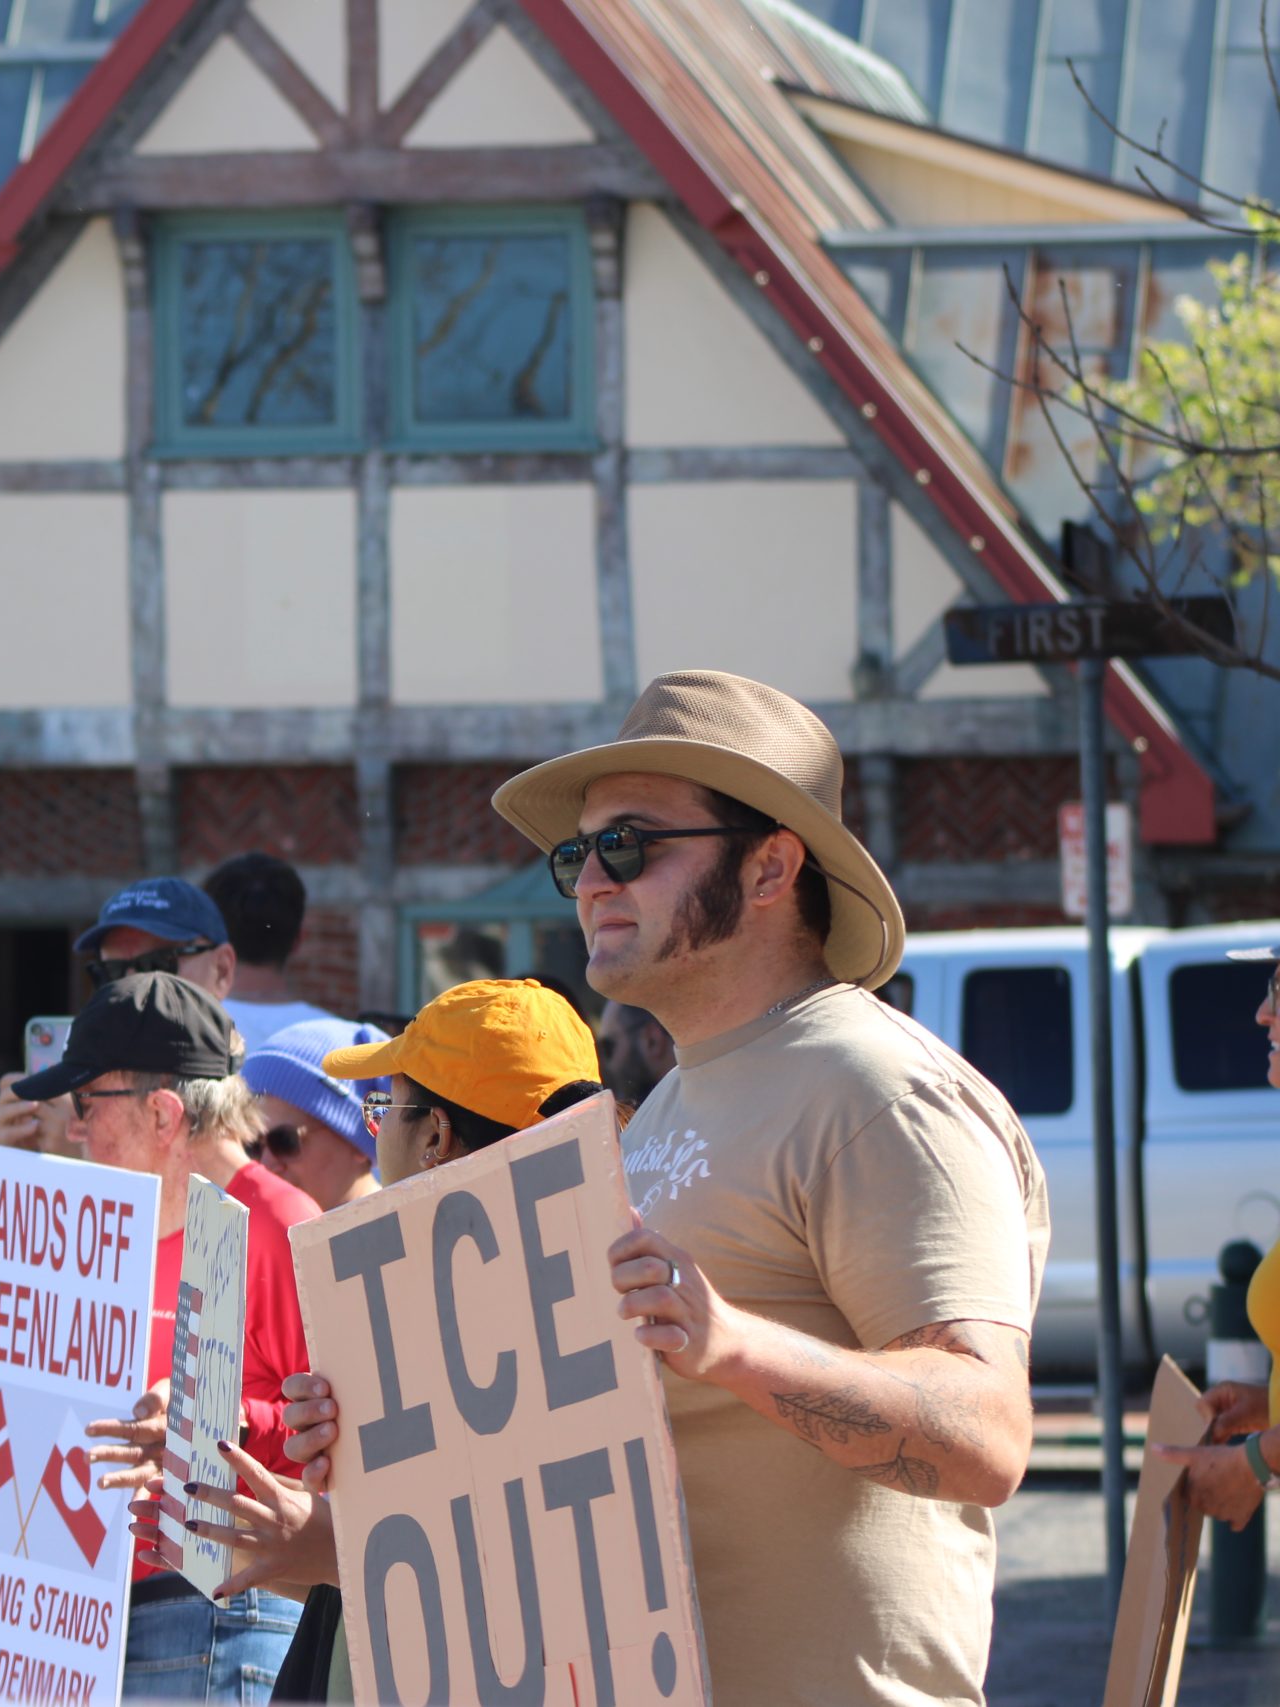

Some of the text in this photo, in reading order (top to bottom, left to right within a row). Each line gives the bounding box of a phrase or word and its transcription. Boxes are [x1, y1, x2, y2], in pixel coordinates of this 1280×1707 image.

[987, 607, 1106, 656] FIRST
[76, 1194, 134, 1284] OFF
[328, 1137, 619, 1474] ICE
[194, 1337, 236, 1442] RESIST
[30, 1583, 113, 1650] STANDS
[363, 1436, 678, 1707] OUT!
